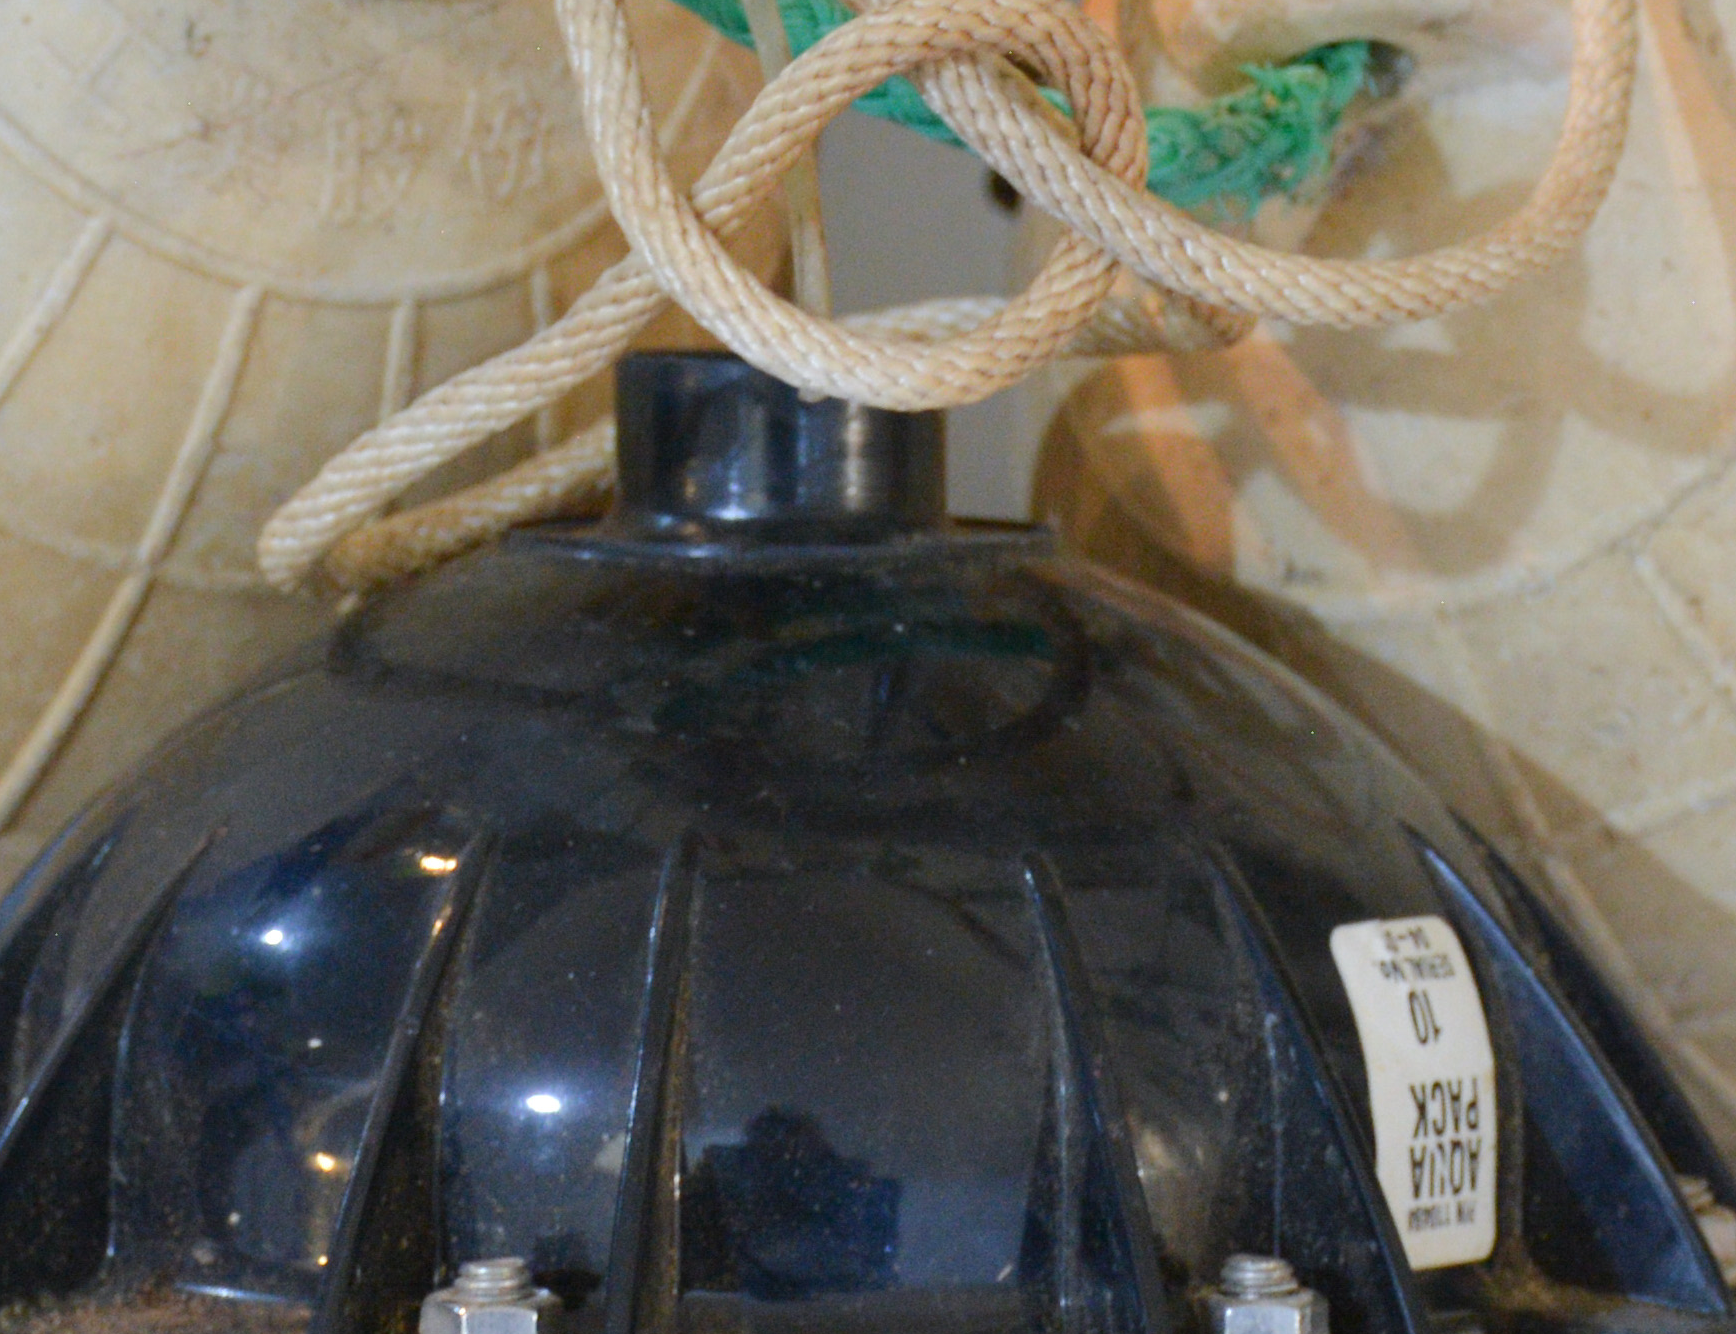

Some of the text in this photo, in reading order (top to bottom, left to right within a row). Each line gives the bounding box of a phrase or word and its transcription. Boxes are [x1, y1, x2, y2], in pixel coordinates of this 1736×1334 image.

[1407, 989, 1443, 1045] 10
[1408, 1077, 1482, 1199] AQUA PACK
